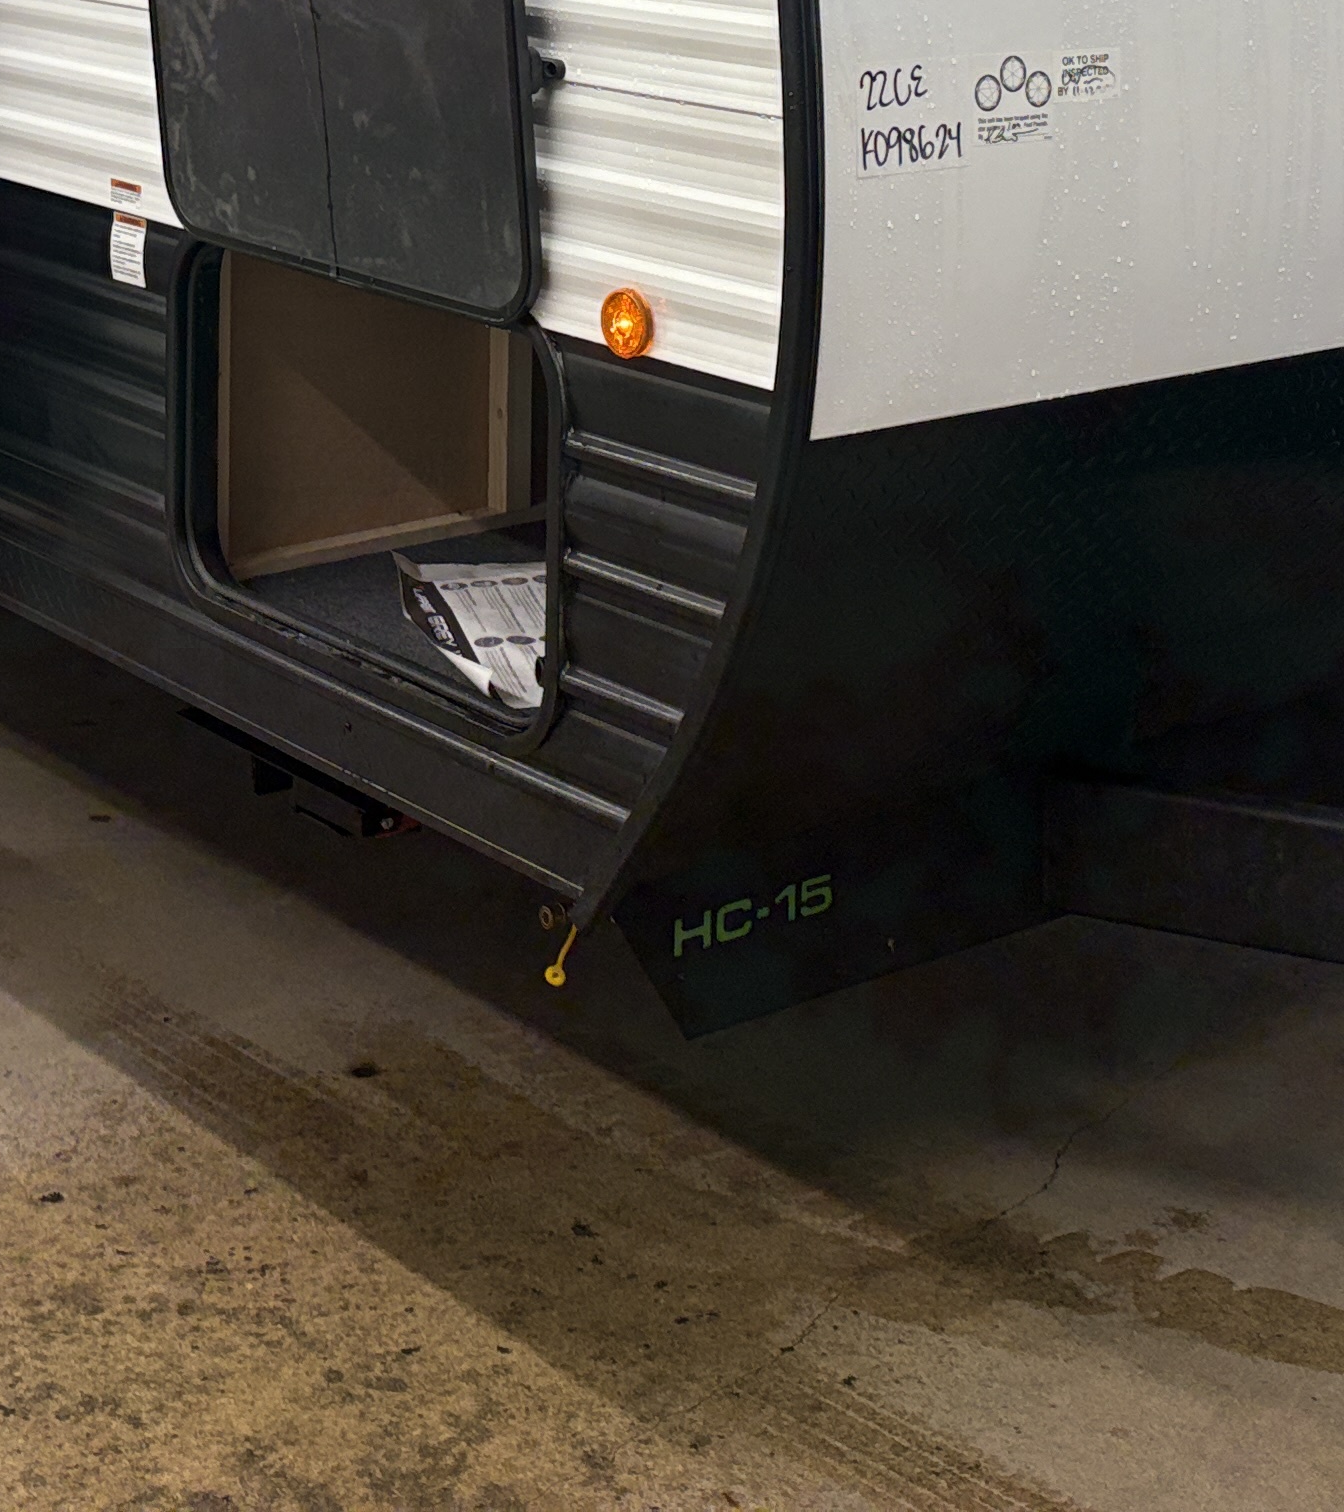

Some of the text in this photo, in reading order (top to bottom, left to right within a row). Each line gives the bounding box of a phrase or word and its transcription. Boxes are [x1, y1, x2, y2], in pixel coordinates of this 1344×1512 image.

[1061, 55, 1076, 66] OK
[1076, 54, 1089, 65] TO
[860, 121, 962, 171] K098624
[673, 873, 833, 958] HC-15
